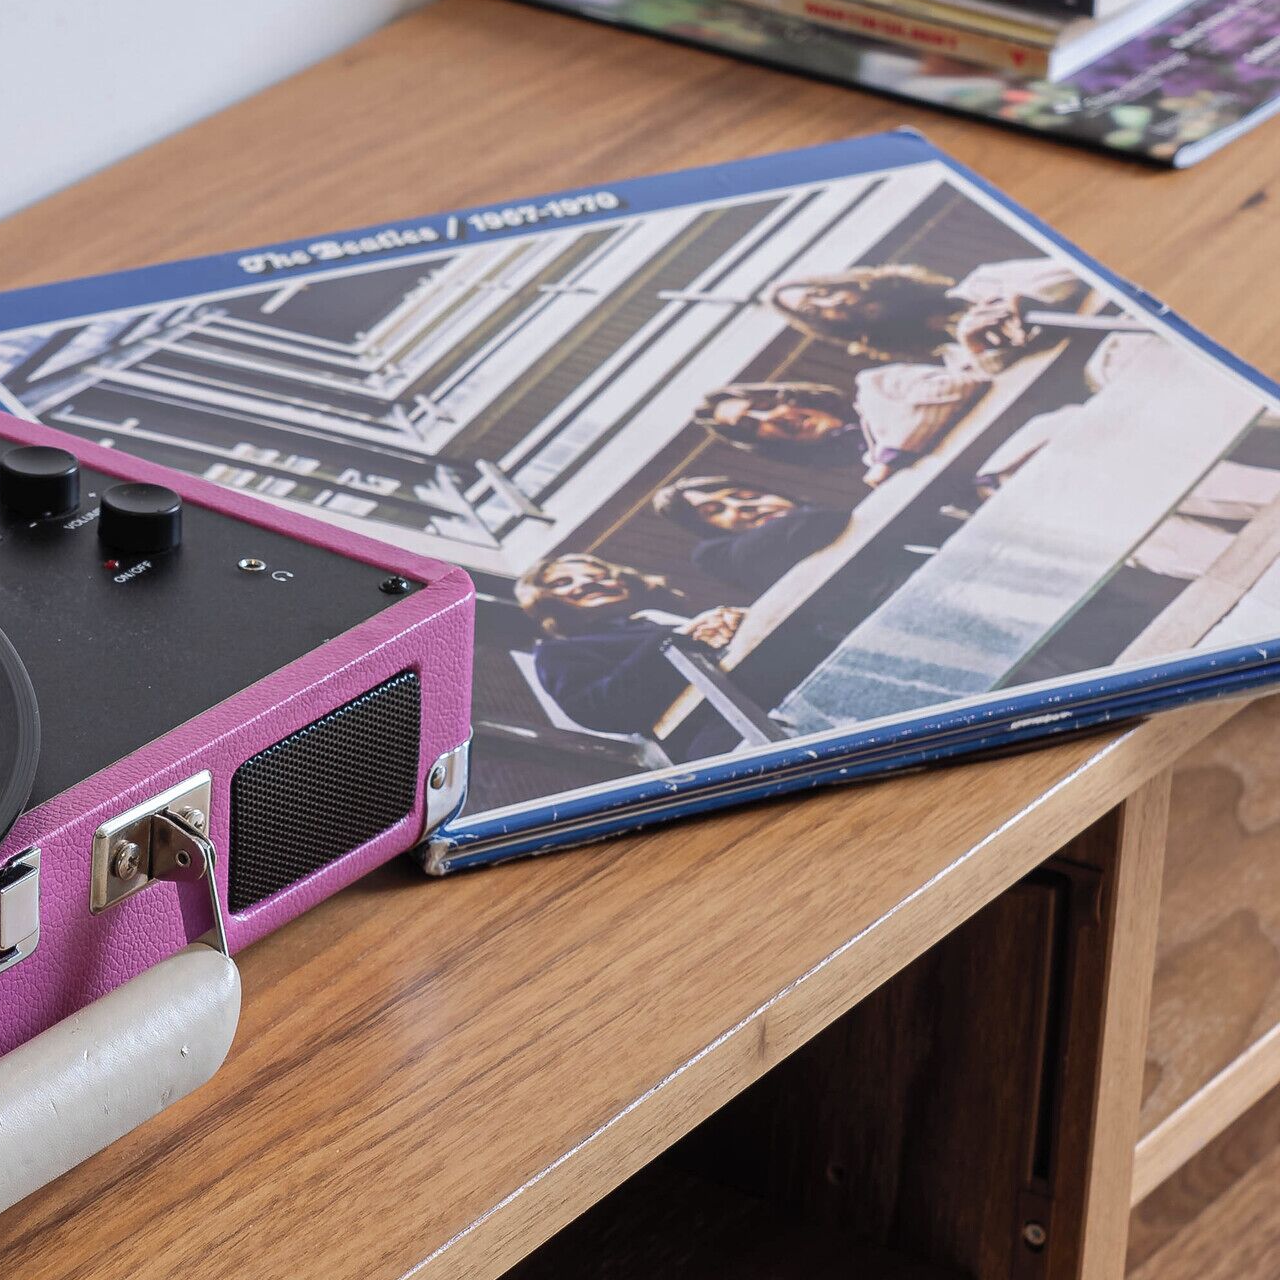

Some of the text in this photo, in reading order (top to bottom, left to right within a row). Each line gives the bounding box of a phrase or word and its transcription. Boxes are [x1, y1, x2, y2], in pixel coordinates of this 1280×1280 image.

[237, 252, 312, 274] The
[307, 226, 440, 262] Beatles
[466, 191, 620, 232] 1967-1970
[63, 506, 101, 530] VOLUM
[114, 560, 153, 584] ON/OFF
